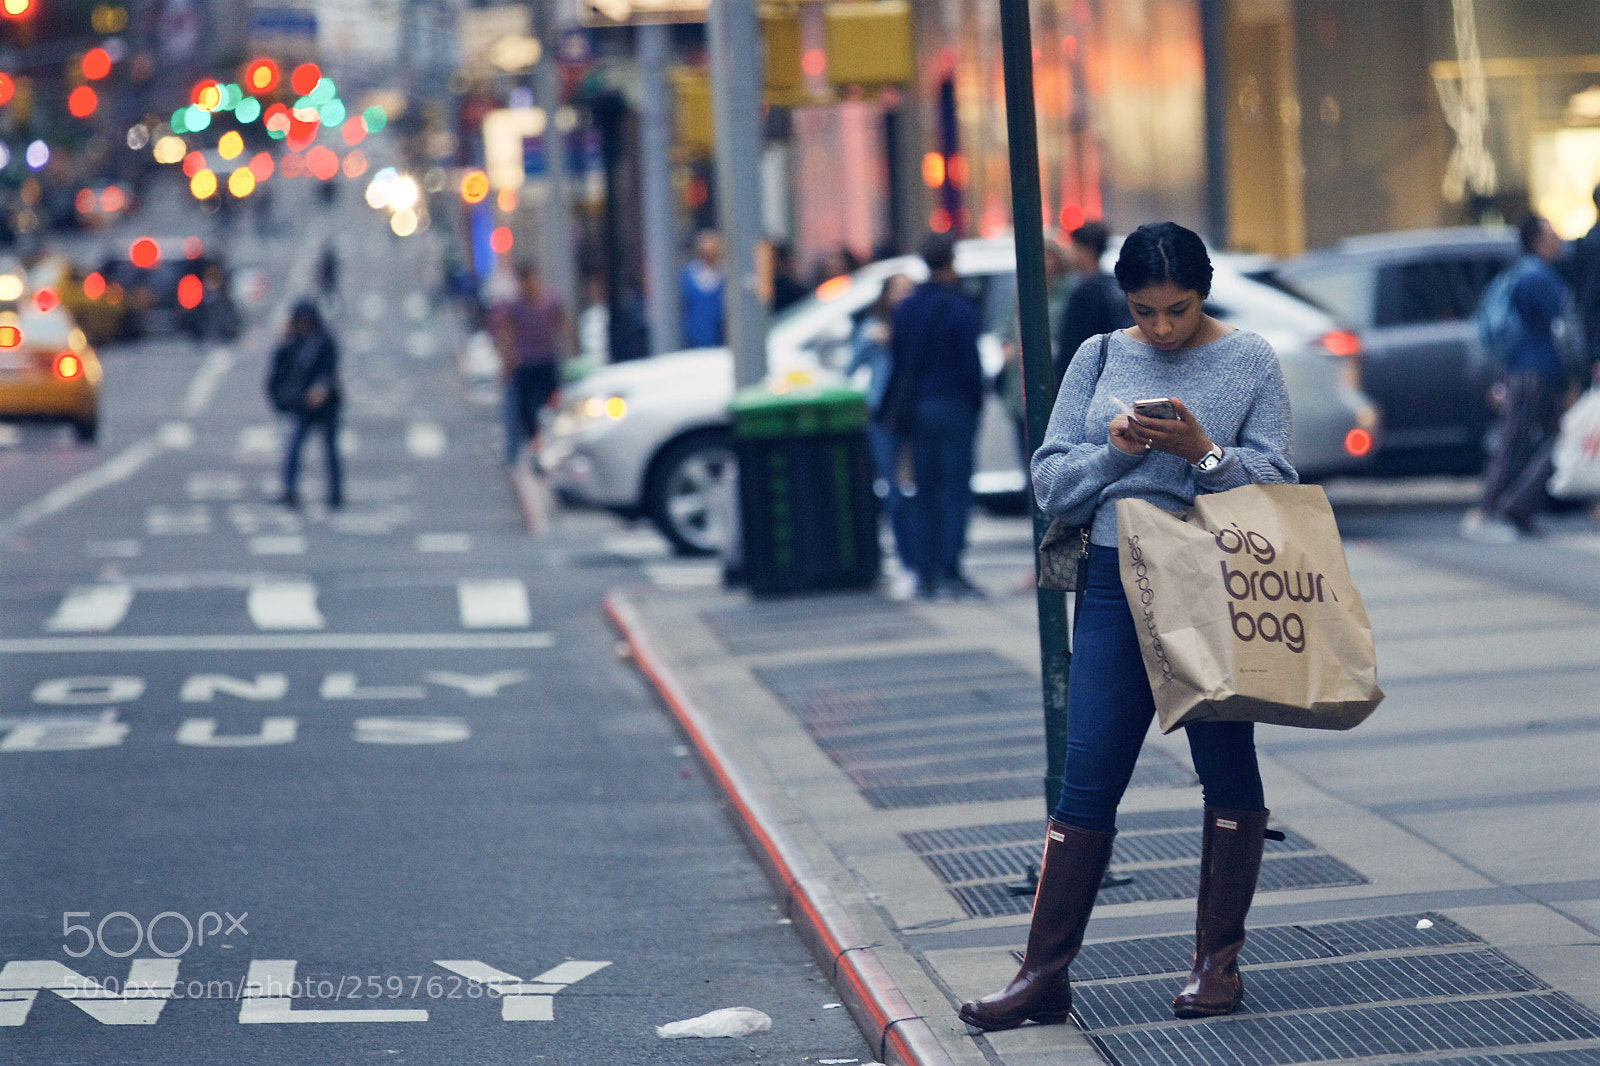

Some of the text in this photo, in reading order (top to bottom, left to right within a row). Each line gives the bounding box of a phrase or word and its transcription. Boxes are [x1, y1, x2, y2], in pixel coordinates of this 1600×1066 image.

[1227, 601, 1306, 654] bag
[32, 670, 533, 705] ONLY
[0, 958, 613, 1026] NLY
